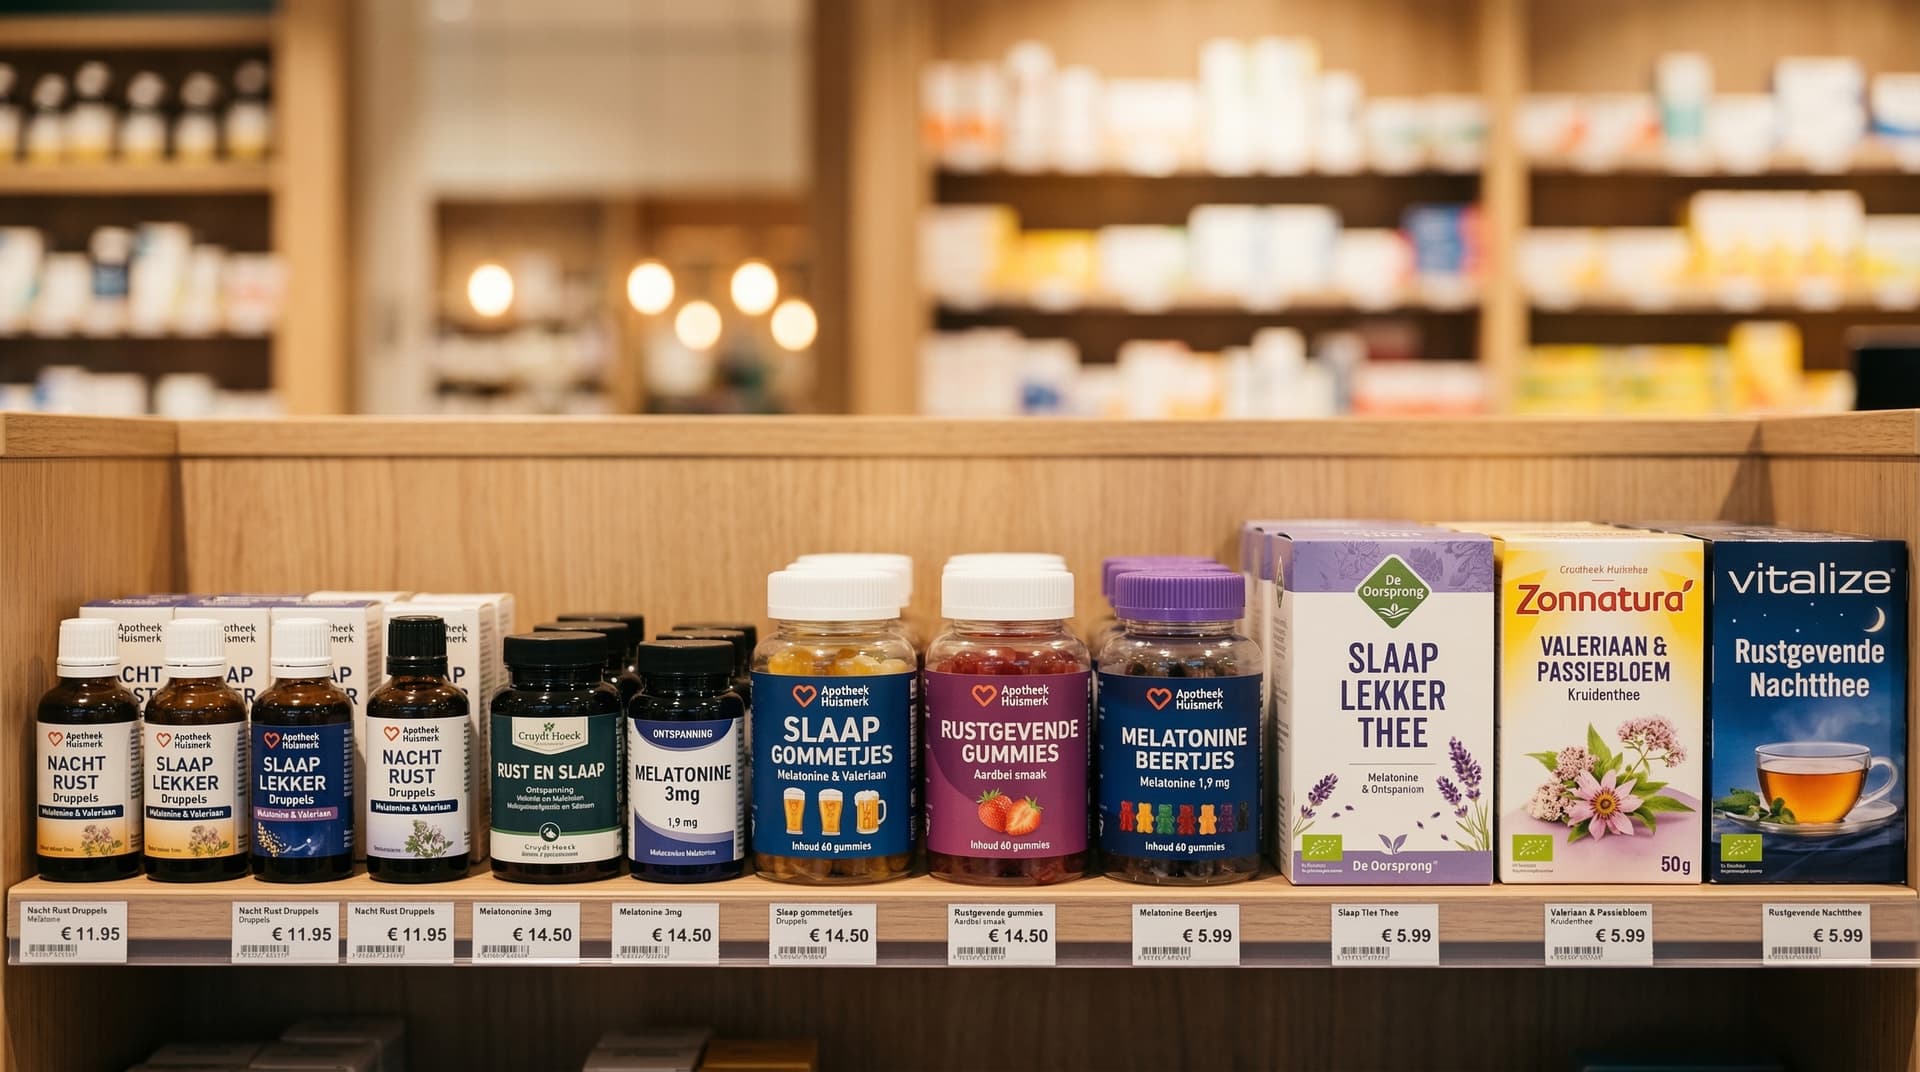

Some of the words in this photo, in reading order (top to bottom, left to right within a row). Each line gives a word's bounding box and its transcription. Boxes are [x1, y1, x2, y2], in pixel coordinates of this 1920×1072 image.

[1386, 575, 1401, 586] De
[1728, 562, 1891, 594] vitalize
[1363, 586, 1424, 600] Oorsprong
[1516, 584, 1684, 615] Zonnatura
[118, 623, 162, 634] Apotheek
[1541, 636, 1647, 656] VALERIAAN
[1653, 636, 1667, 657] &
[1348, 642, 1439, 674] SLAAP
[1735, 638, 1885, 669] Rustgevende
[1538, 661, 1671, 682] PASSIEBLOEM
[821, 685, 870, 697] Apotheek
[1001, 684, 1049, 697] Apotheek
[1750, 672, 1870, 698] Nachtthee
[1001, 696, 1049, 706] Huismerk
[1176, 688, 1224, 701] Apotheek
[1341, 680, 1446, 711] LEKKER
[1568, 688, 1641, 701] Kruidenthee
[821, 697, 870, 707] Huismerk
[1176, 700, 1224, 710] Huismerk
[403, 726, 440, 736] Apotheek
[653, 729, 713, 740] ONTSPANNING
[783, 716, 880, 743] SLAAP
[941, 719, 1079, 741] RUSTGEVENDE
[1357, 717, 1428, 748] THEE
[403, 735, 440, 743] Huismerk
[518, 731, 549, 743] Cruydt
[551, 731, 581, 741] Hoeck
[1121, 727, 1248, 748] MELATONINE
[66, 740, 103, 748] Huismerk
[174, 741, 212, 750] Huismerk
[383, 749, 442, 765] NACHT
[771, 745, 893, 766] GOMMETJES
[962, 744, 1059, 764] GUMMIES
[1136, 751, 1235, 770] BEERTJES
[47, 755, 106, 772] NACHT
[156, 756, 213, 772] SLAAP
[263, 756, 321, 773] SLAAP
[389, 768, 436, 784] RUST
[497, 762, 530, 780] RUST
[534, 763, 555, 780] EN
[559, 762, 606, 780] SLAAP
[635, 764, 732, 783] MELATONINE
[777, 769, 829, 782] Melatonine
[831, 771, 840, 782] &
[842, 770, 887, 781] Valeriaan
[974, 769, 1013, 780] Aardbei
[1014, 769, 1047, 780] smaak
[1368, 772, 1419, 783] Melatonine
[53, 774, 99, 790] RUST
[153, 775, 219, 791] LEKKER
[259, 775, 326, 791] LEKKER
[1140, 776, 1196, 788] Melatonine
[1198, 778, 1213, 790] 1,9
[1215, 780, 1230, 790] mg
[389, 787, 436, 800] Druppels
[526, 785, 574, 795] Ontspanning
[664, 785, 700, 805] 3mg
[1361, 785, 1369, 794] &
[53, 793, 99, 805] Druppels
[161, 794, 208, 806] Druppels
[269, 794, 314, 807] Druppels
[75, 809, 81, 817] &
[183, 809, 189, 817] &
[412, 803, 418, 812] &
[667, 817, 681, 829] 1,9
[683, 818, 698, 829] mg
[792, 841, 820, 851] Inhoud
[821, 842, 832, 852] 60
[833, 842, 872, 854] gummies
[970, 840, 999, 850] Inhoud
[1000, 840, 1011, 850] 60
[1013, 840, 1050, 853] gummies
[1145, 841, 1174, 852] Inhoud
[1175, 843, 1187, 852] 60
[1188, 842, 1225, 854] gummies
[1352, 860, 1369, 872] De
[1370, 860, 1433, 874] Oorsprong
[52, 906, 71, 915] Rust
[72, 906, 108, 917] Druppels
[263, 907, 282, 916] Rust
[283, 907, 319, 917] Druppels
[354, 907, 378, 916] Nacht
[379, 907, 398, 916] Rust
[399, 907, 435, 917] Druppels
[534, 908, 552, 917] 3mg
[619, 908, 663, 916] Melatonine
[954, 909, 1006, 918] Rustgevende
[1007, 909, 1044, 918] gummies
[1139, 909, 1183, 917] Melatonine
[1184, 909, 1218, 919] Beertjes
[1338, 909, 1360, 918] Slaap
[1768, 909, 1820, 918] Rustgevende
[1822, 909, 1862, 917] Nachtthee
[238, 916, 271, 925] Druppels
[61, 926, 72, 941] €
[76, 926, 120, 941] 11.95
[272, 927, 282, 941] €
[288, 927, 332, 941] 11.95
[387, 927, 398, 941] €
[403, 927, 447, 941] 11.95
[512, 927, 523, 941] €
[528, 927, 572, 941] 14.50
[652, 927, 662, 942] €
[667, 927, 712, 942] 14.50
[809, 928, 820, 942] €
[825, 928, 869, 942] 14.50
[988, 928, 999, 943] €
[1004, 928, 1048, 943] 14.50
[1182, 928, 1193, 943] €
[1198, 928, 1232, 943] 5.99
[1381, 928, 1392, 943] €
[1397, 928, 1431, 943] 5.99
[1595, 928, 1606, 943] €
[1611, 928, 1645, 943] 5.99
[1813, 928, 1824, 942] €
[1828, 928, 1863, 942] 5.99
